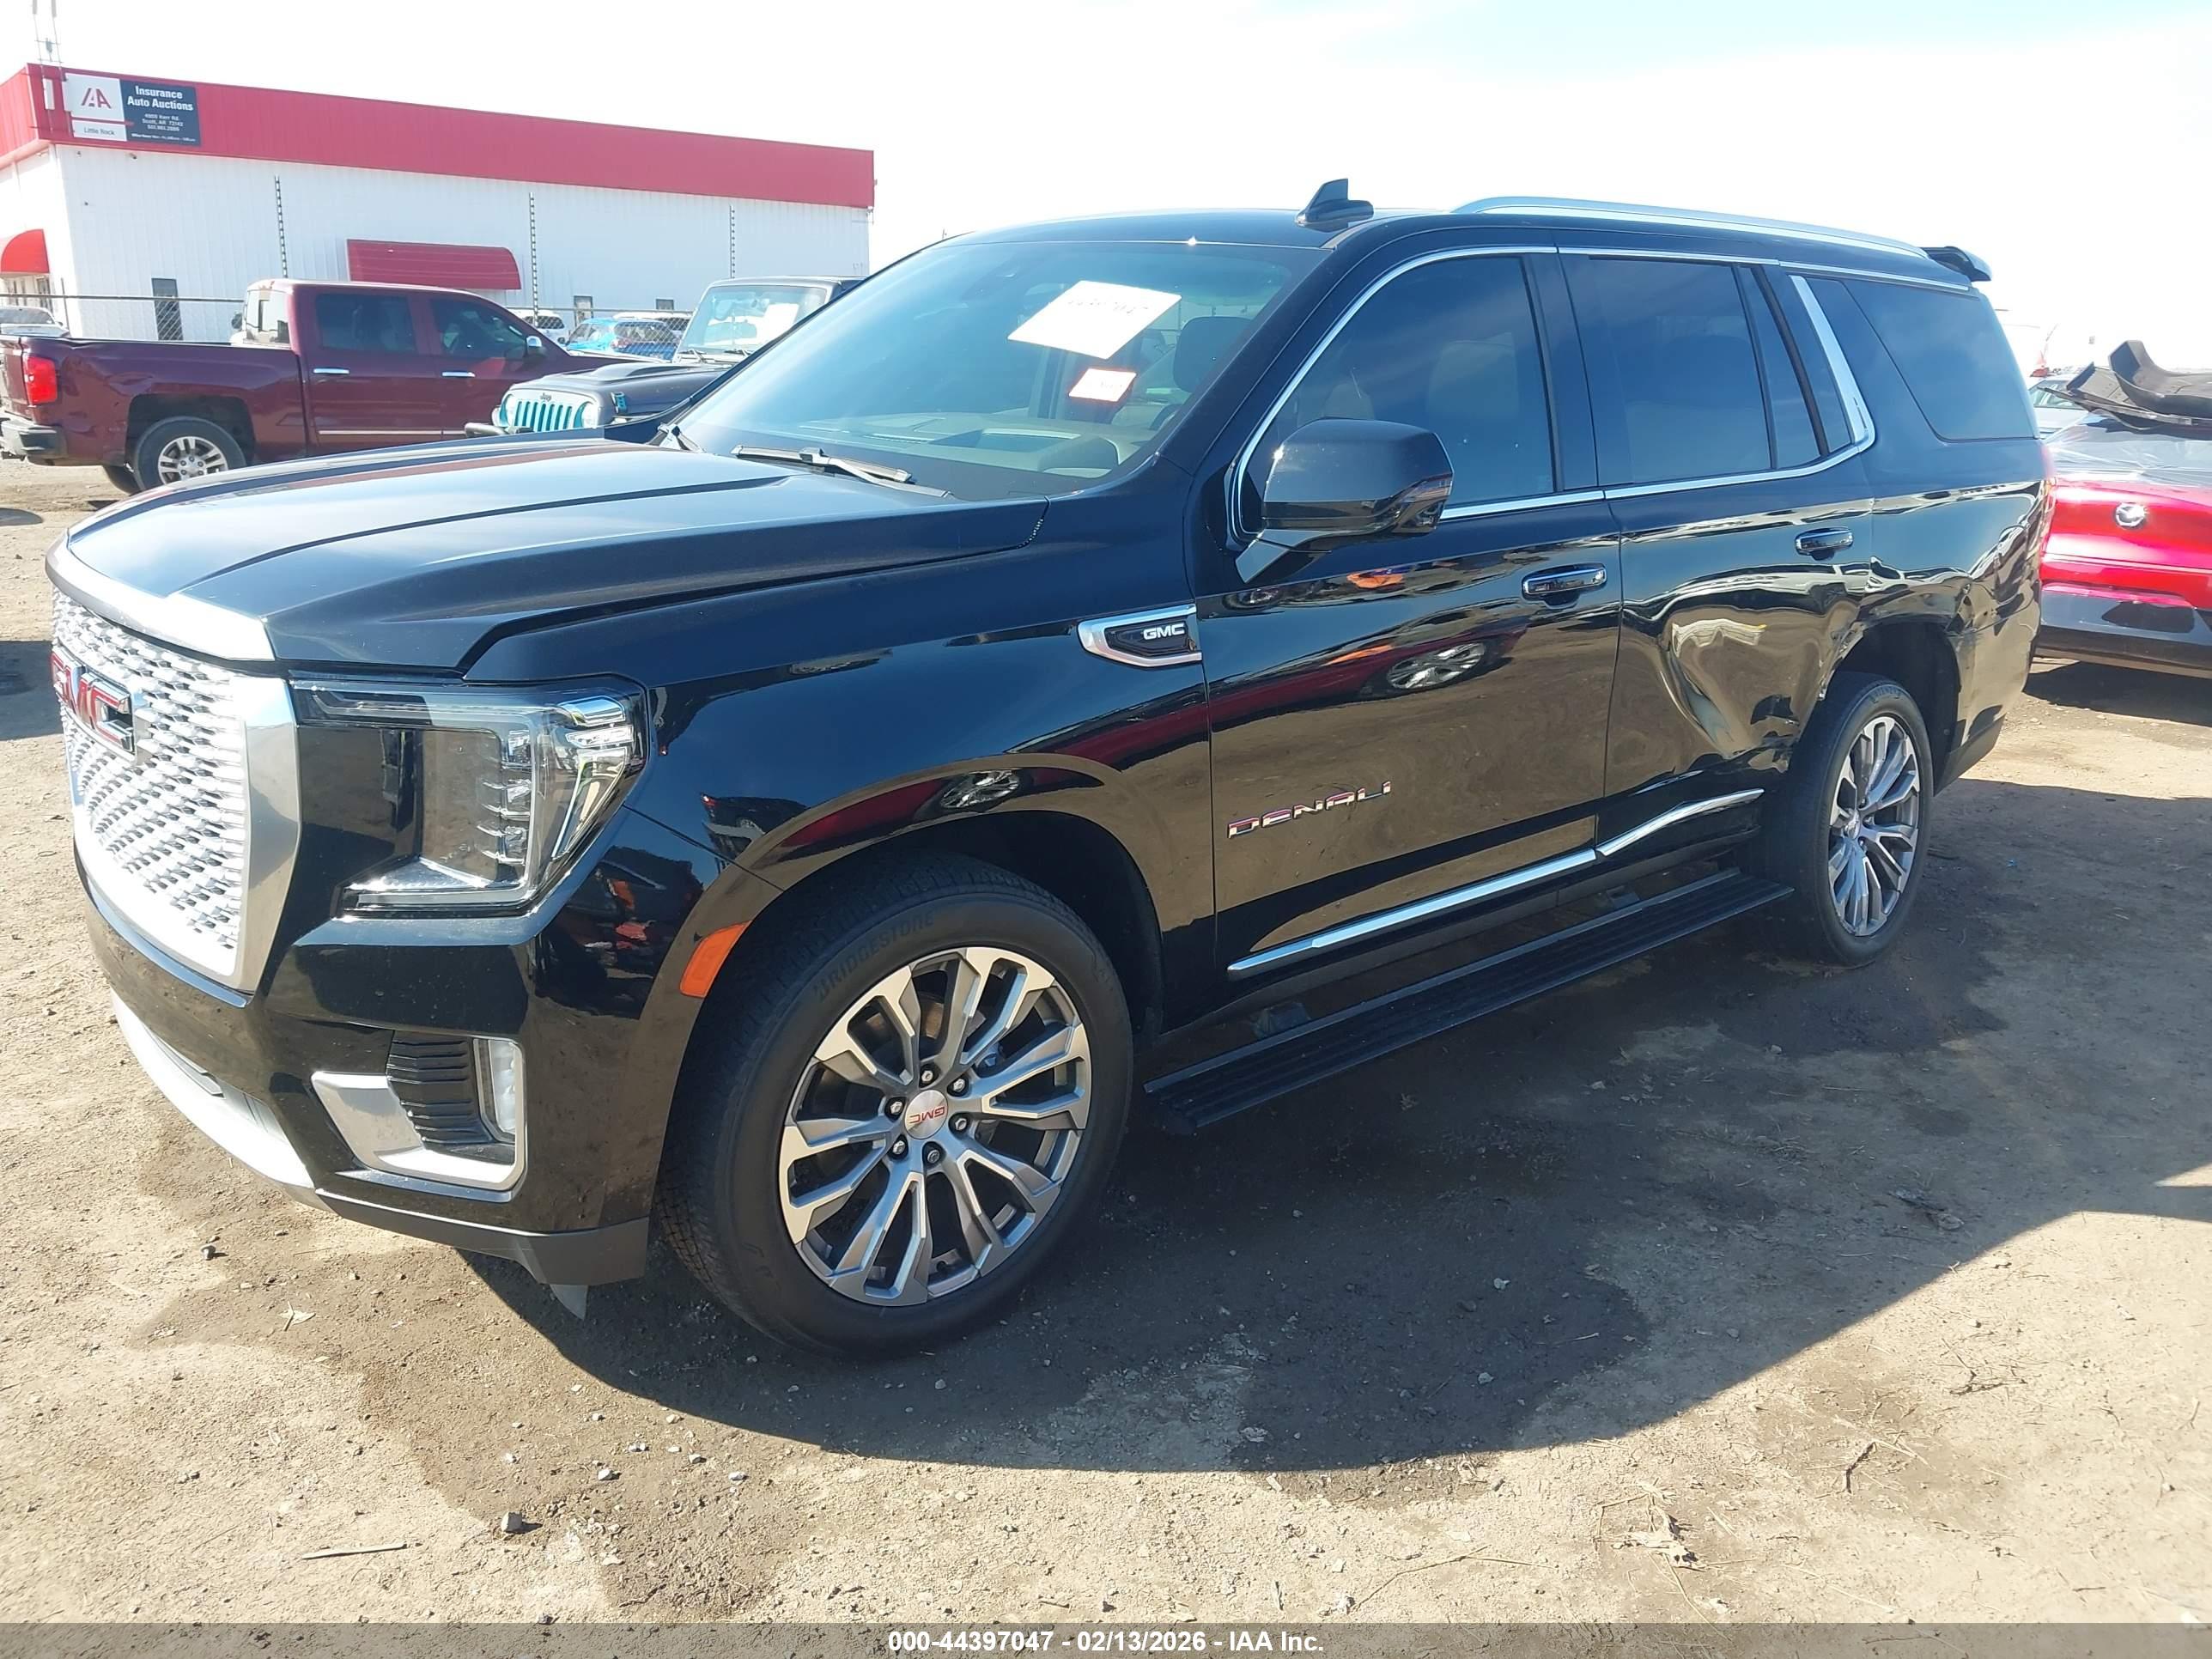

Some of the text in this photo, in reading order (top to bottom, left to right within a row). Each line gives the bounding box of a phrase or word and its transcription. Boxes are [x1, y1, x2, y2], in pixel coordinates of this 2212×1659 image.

[135, 86, 183, 99] Insurance
[127, 95, 194, 111] Auto Auctions
[1143, 622, 1185, 641] GMC
[1227, 780, 1392, 839] DENALI
[909, 1106, 945, 1124] GMC
